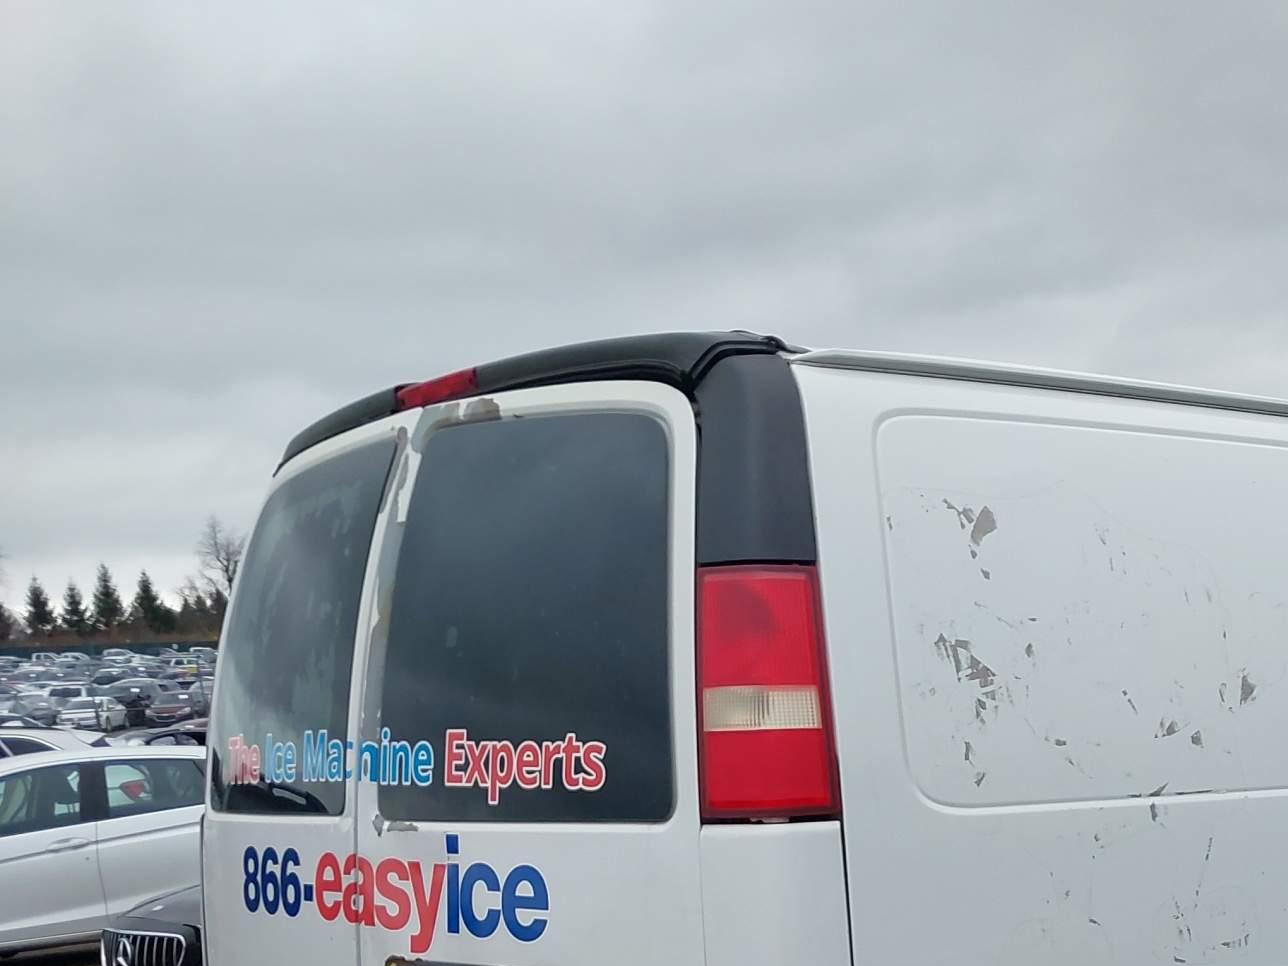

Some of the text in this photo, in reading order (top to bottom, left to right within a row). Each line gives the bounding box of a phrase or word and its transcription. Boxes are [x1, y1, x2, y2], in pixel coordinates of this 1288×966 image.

[228, 733, 261, 784] The
[264, 733, 297, 783] Ice
[444, 728, 607, 804] Experts
[242, 833, 550, 954] 866-easyice
